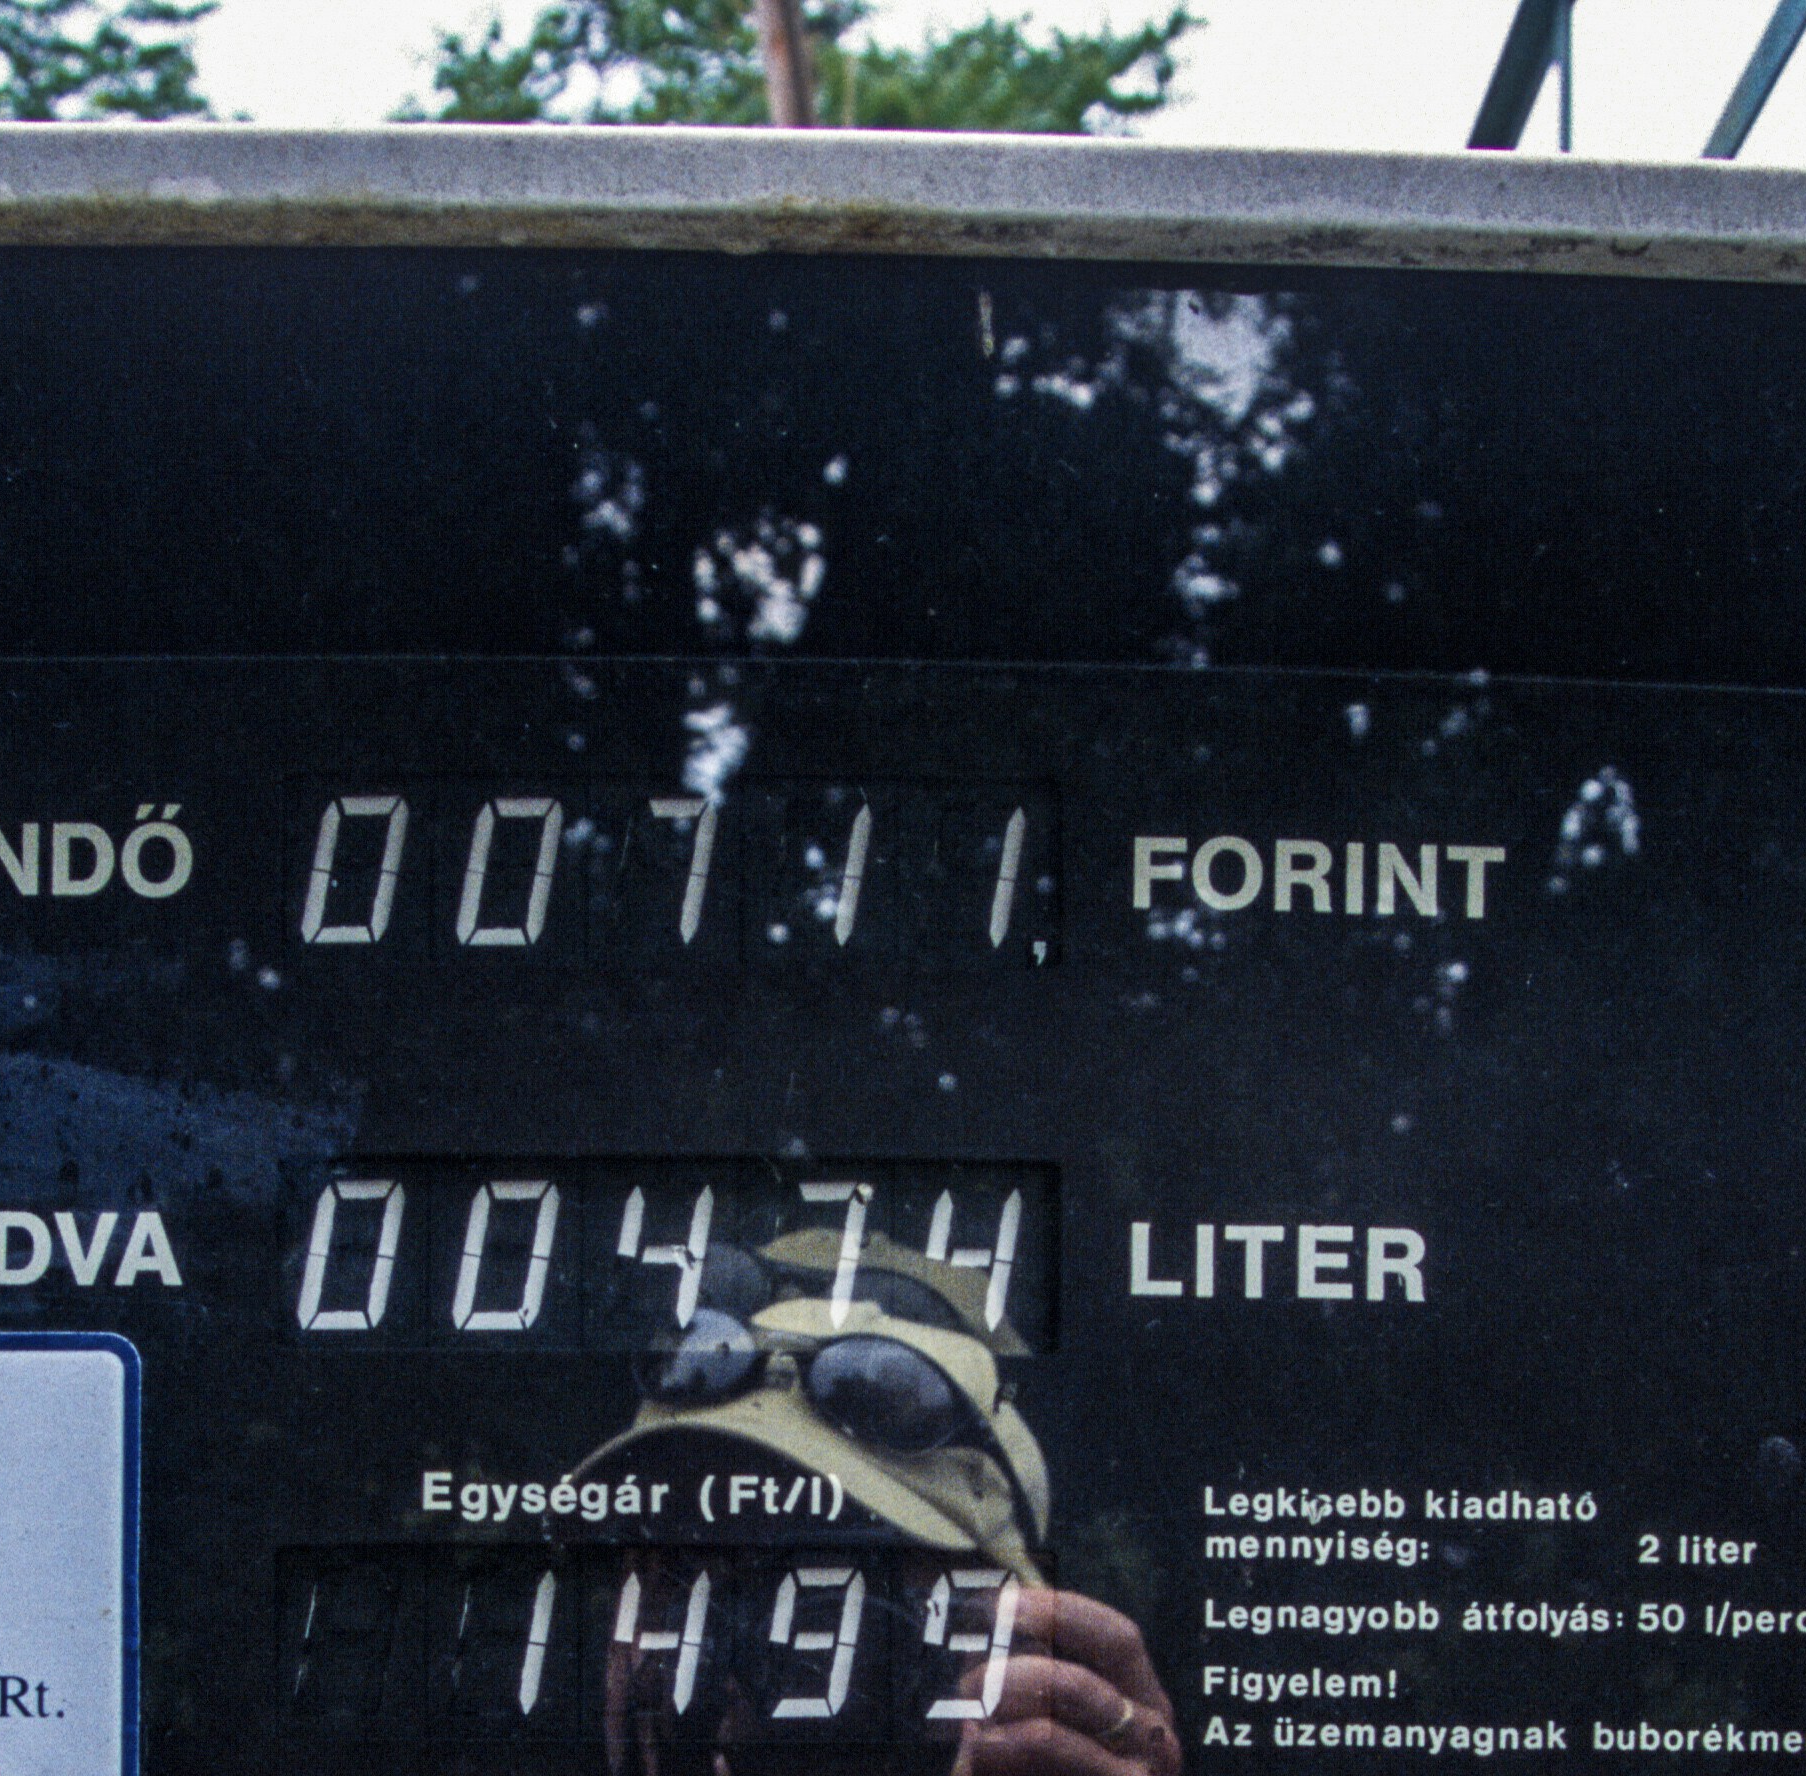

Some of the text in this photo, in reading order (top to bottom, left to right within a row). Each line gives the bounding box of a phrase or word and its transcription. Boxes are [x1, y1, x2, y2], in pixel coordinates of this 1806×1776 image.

[1132, 836, 1508, 920] FORINT
[295, 1179, 1023, 1332] 00474
[1129, 1223, 1428, 1305] LITER
[422, 1471, 670, 1522] Egységár
[1425, 1490, 1597, 1522] kiadható
[1205, 1530, 1758, 1567] mennyiség: 2 liter
[1204, 1599, 1440, 1635] Legnagyobb
[1461, 1602, 1625, 1638] átfolyás:
[1637, 1604, 1685, 1633] 50
[1203, 1666, 1398, 1702] Figyelem!
[1203, 1716, 1252, 1746] Az
[1274, 1717, 1567, 1756] üzemanyagnak
